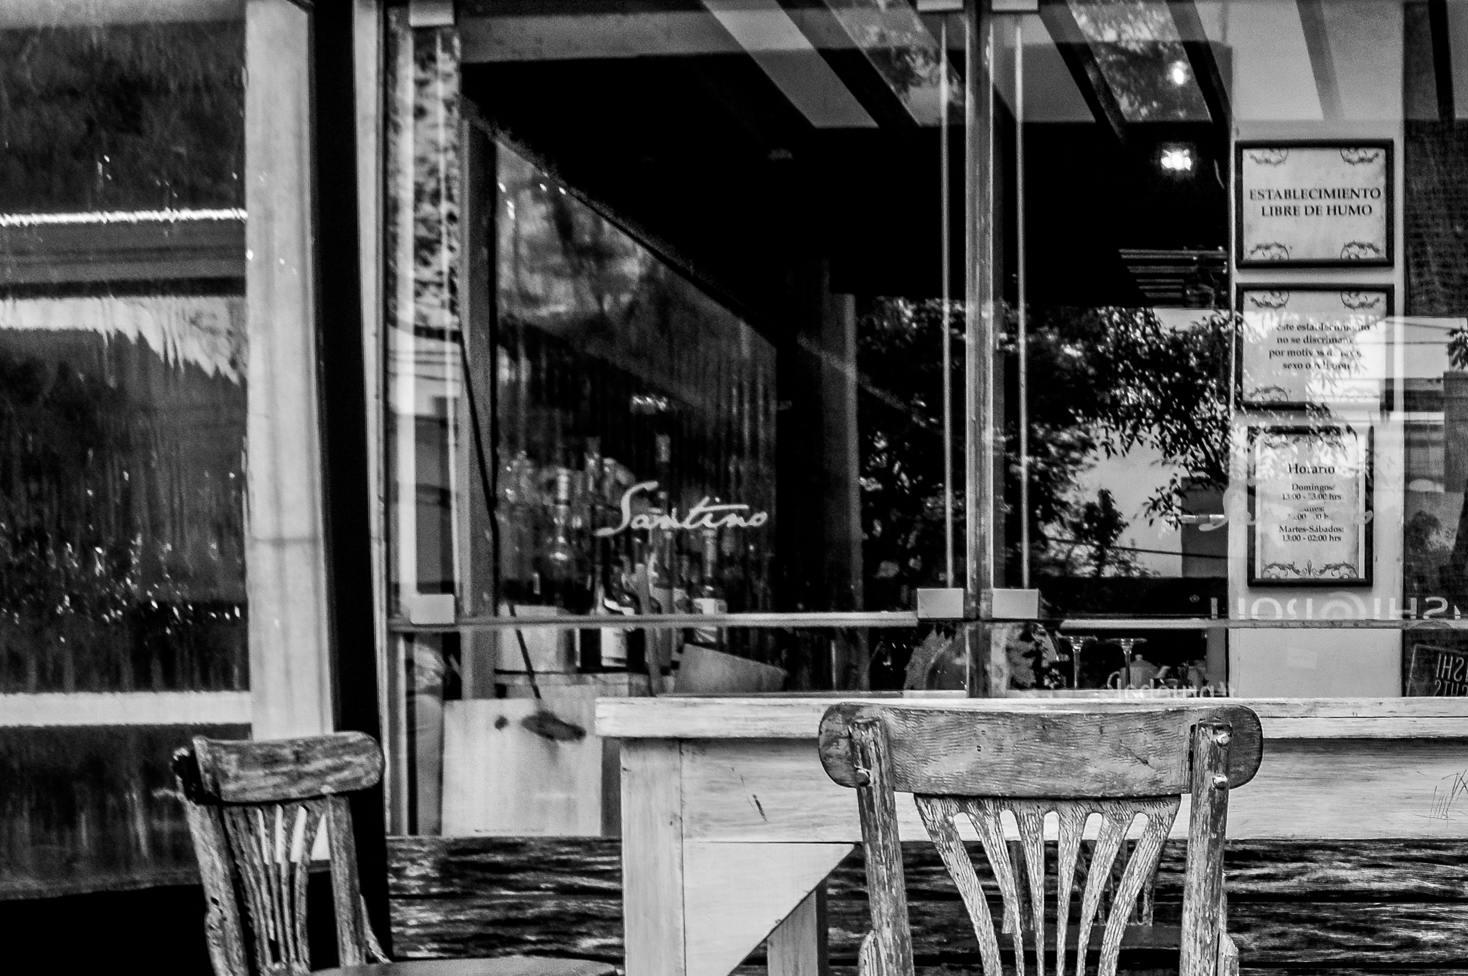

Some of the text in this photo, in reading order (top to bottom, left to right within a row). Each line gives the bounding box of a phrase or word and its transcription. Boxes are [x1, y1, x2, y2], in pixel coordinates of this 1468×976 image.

[1249, 187, 1381, 200] ESTABLECIMIENTO
[1261, 204, 1373, 216] LIBRE DE HUMO
[1269, 349, 1285, 359] por
[594, 480, 769, 537] Santino
